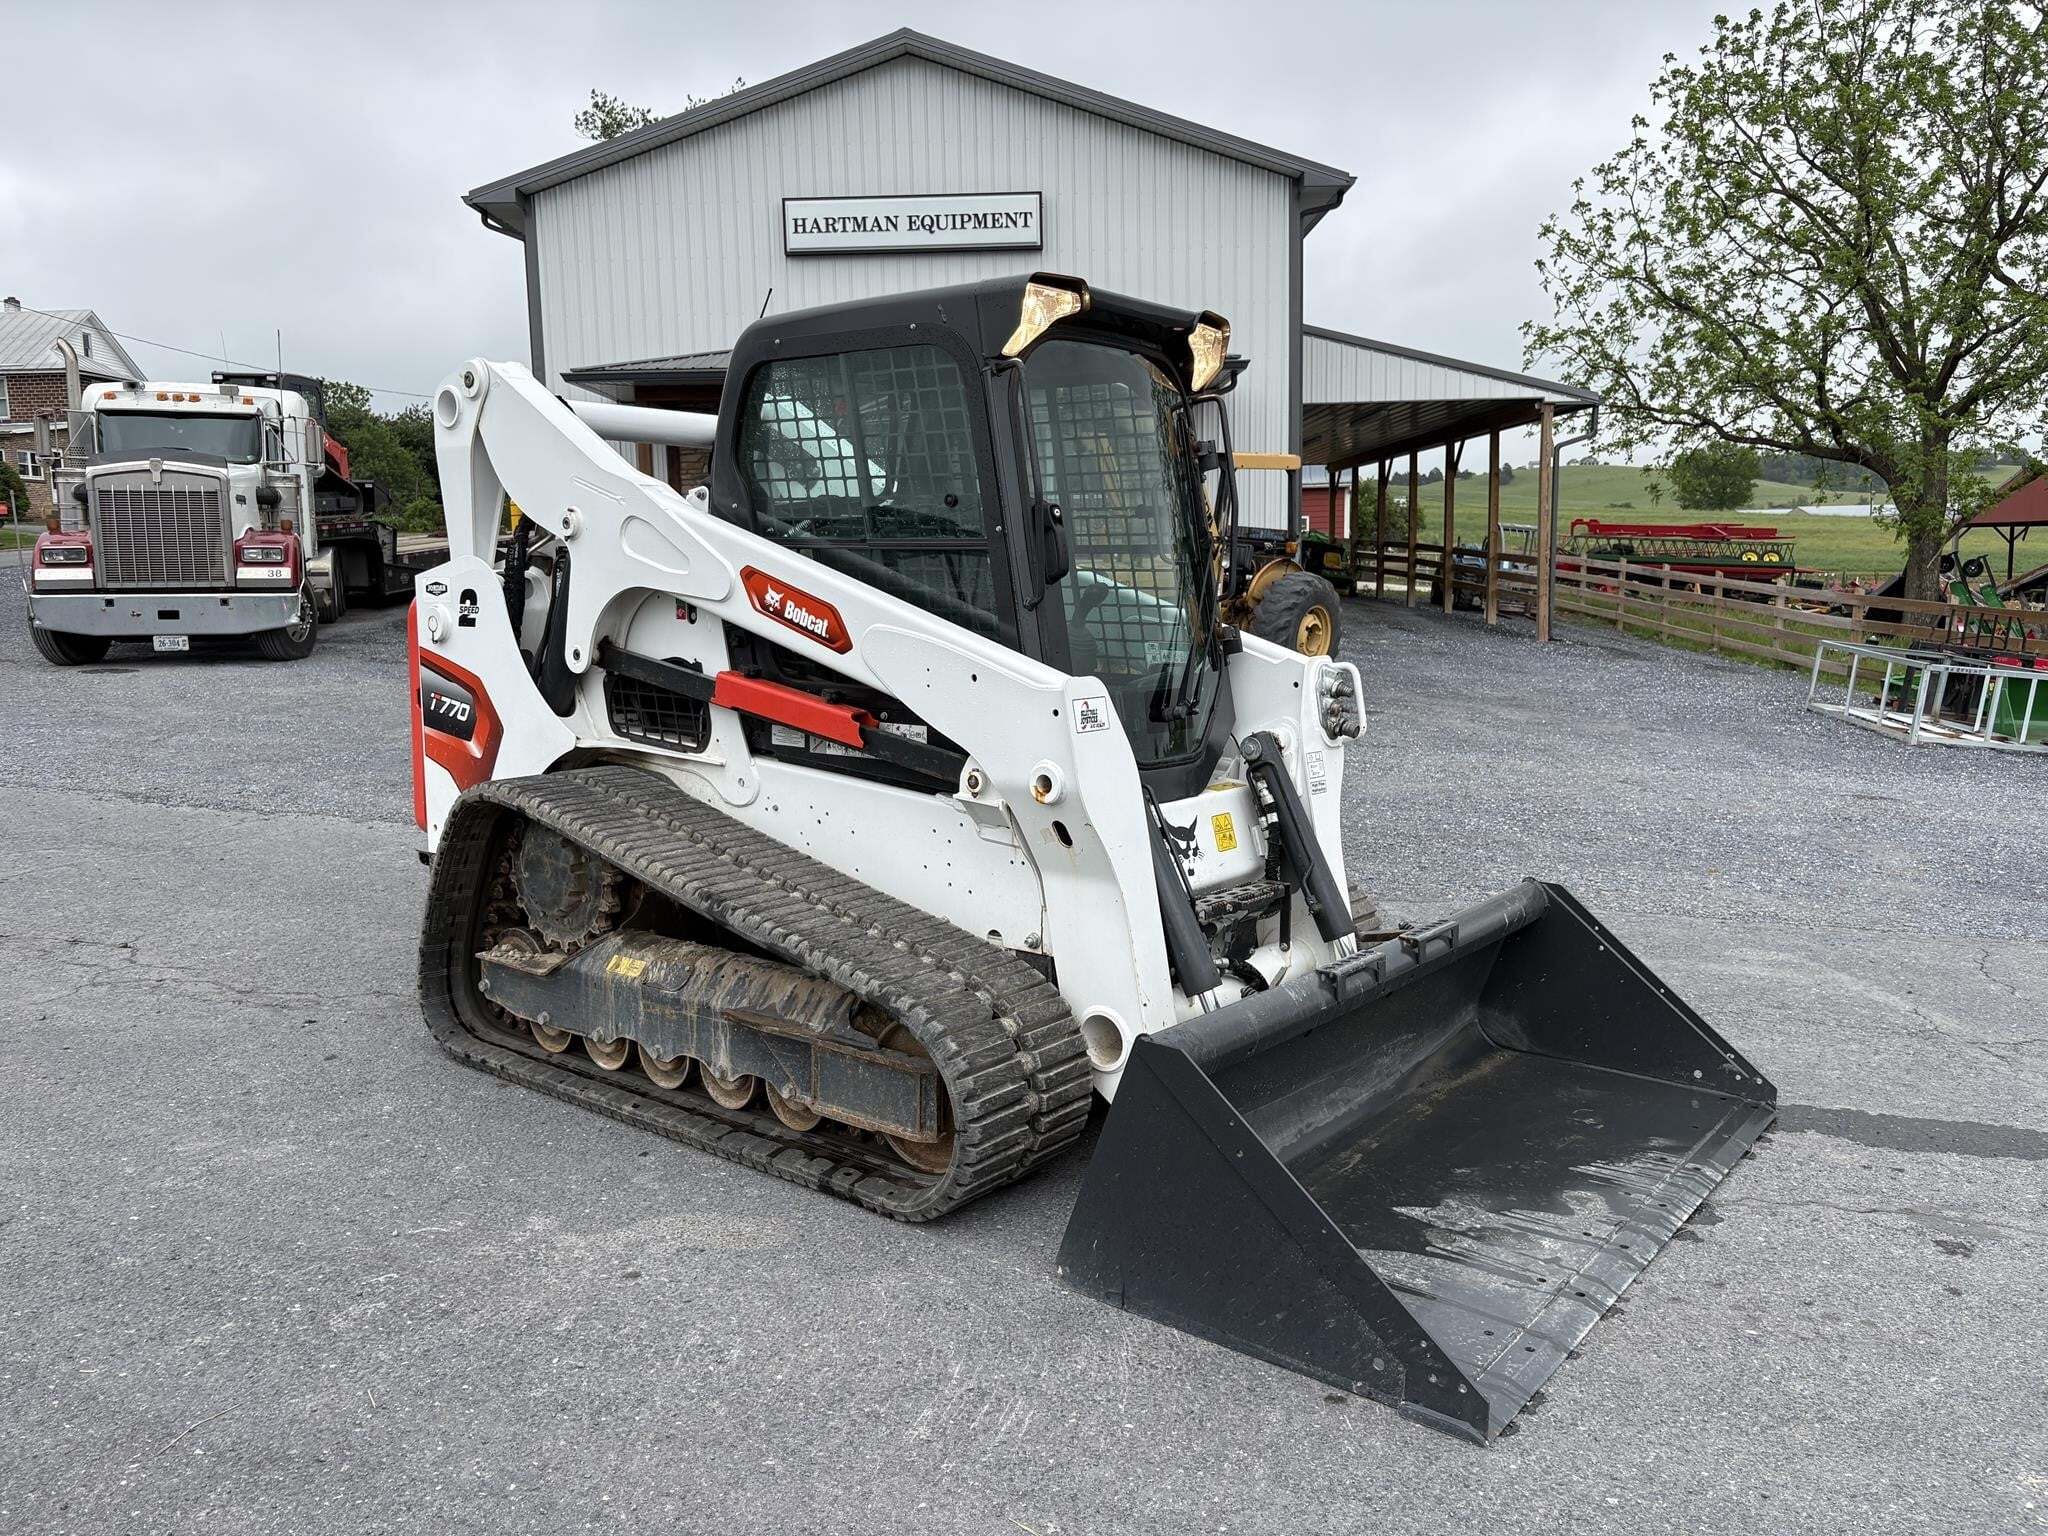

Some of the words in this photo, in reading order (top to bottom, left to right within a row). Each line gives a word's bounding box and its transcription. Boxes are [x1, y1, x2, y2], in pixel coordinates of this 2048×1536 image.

[792, 215, 899, 234] HARTMAN
[906, 211, 1033, 234] EQUIPMENT
[267, 569, 282, 578] 38
[459, 605, 480, 614] SPEED
[784, 600, 829, 638] Bobcat
